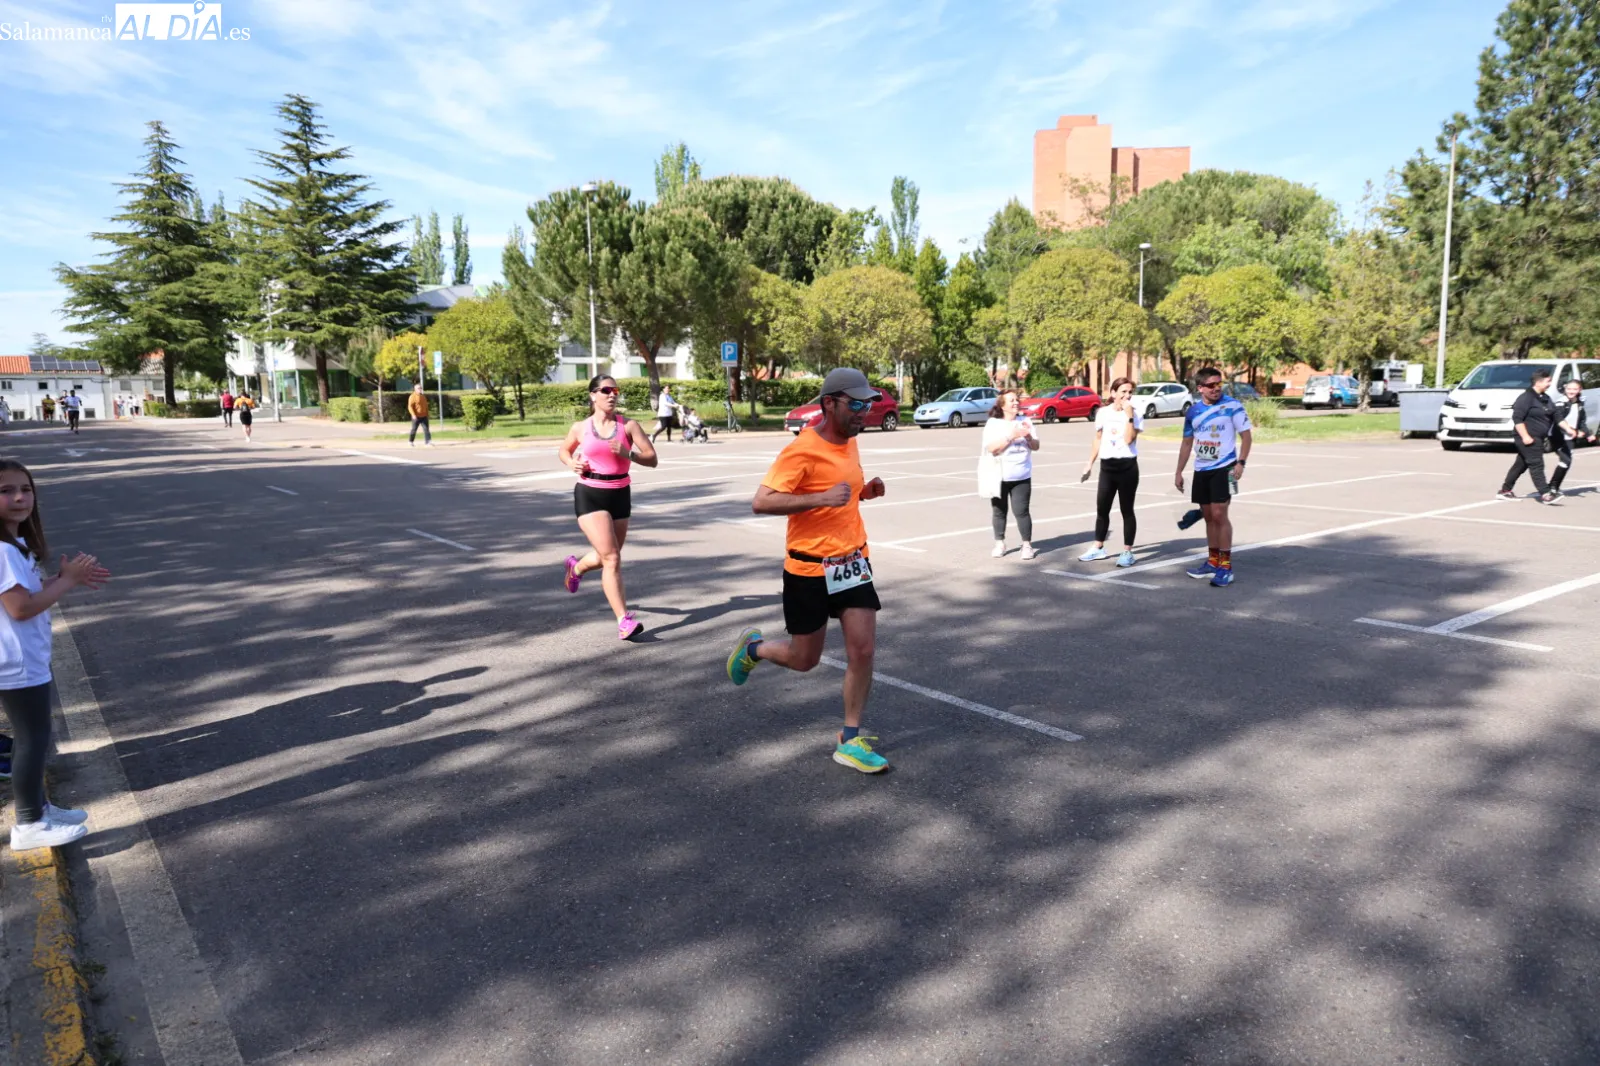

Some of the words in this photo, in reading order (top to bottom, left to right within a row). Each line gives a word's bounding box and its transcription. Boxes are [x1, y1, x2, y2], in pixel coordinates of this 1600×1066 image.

[725, 345, 734, 360] P
[1198, 445, 1216, 455] 490
[833, 561, 861, 582] 468
